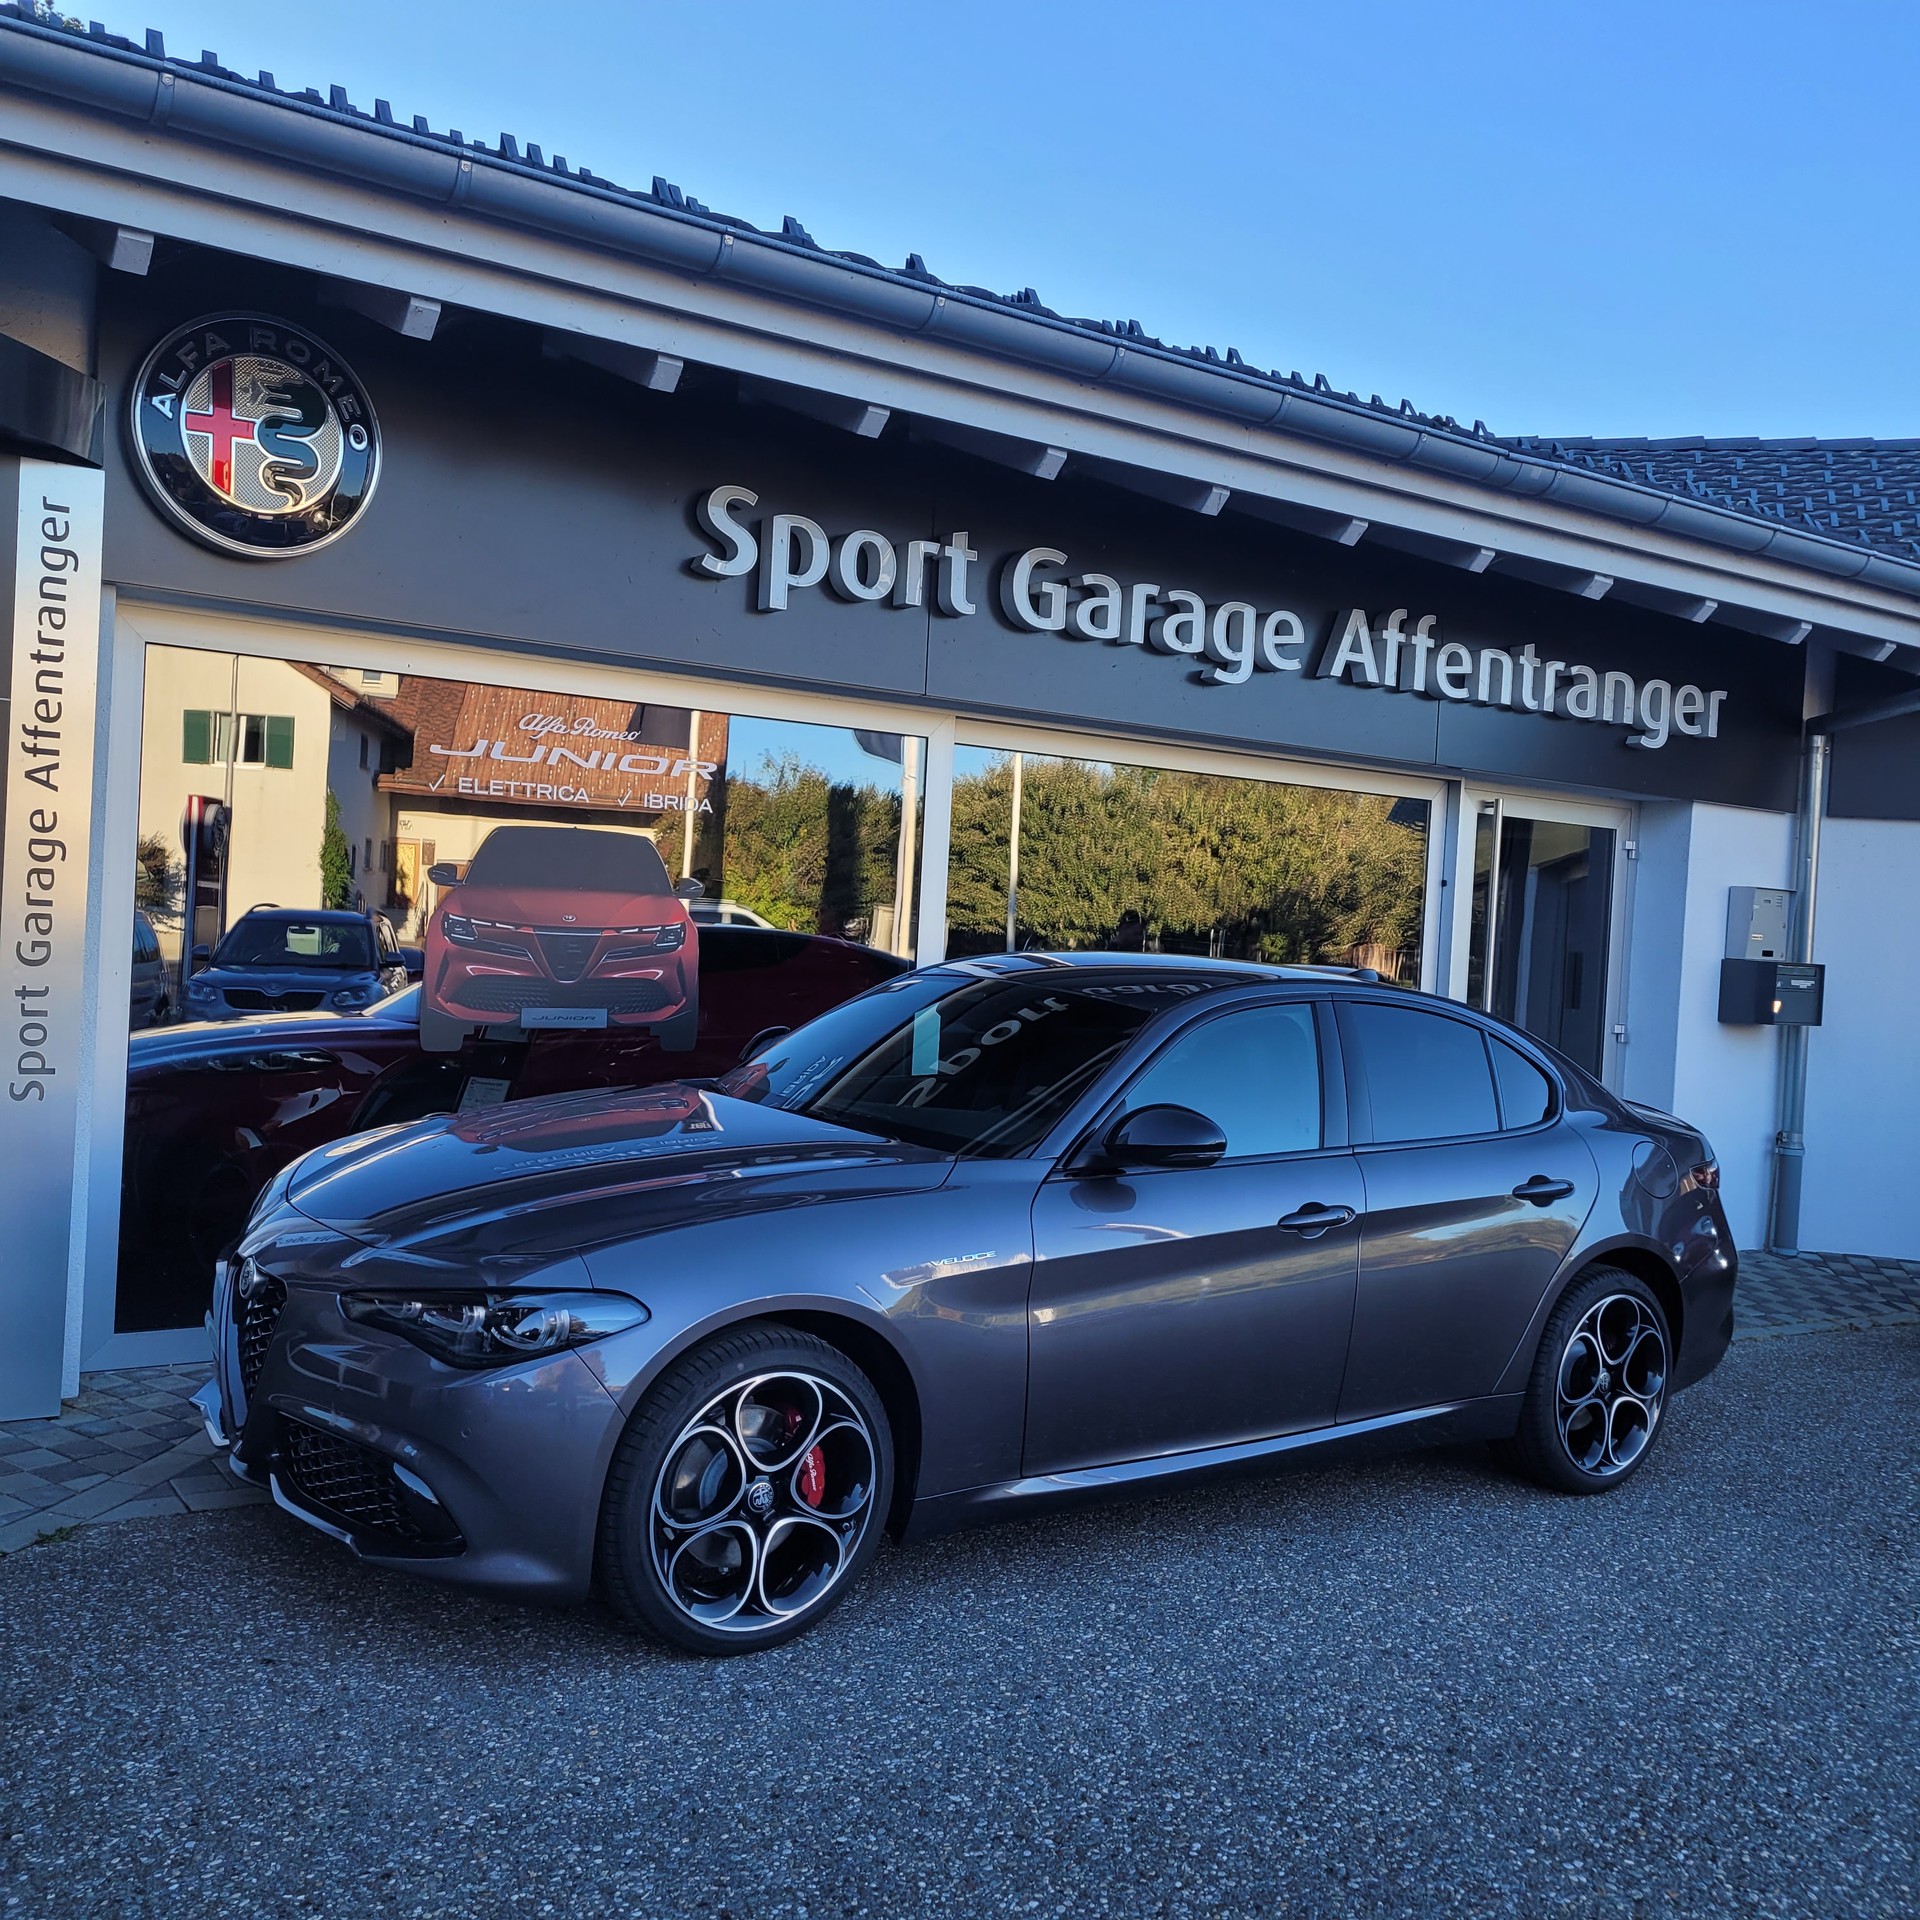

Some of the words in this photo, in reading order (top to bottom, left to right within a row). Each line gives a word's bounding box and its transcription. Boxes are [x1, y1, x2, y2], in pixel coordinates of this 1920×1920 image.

[151, 331, 232, 420] ALFA
[252, 327, 368, 451] ROMEO
[21, 496, 79, 793] Affentranger
[697, 485, 978, 614] Sport
[1003, 547, 1305, 684] Garage
[1324, 608, 1728, 749] Affentranger
[429, 738, 718, 781] JUNIOR
[518, 713, 571, 740] Alfa
[571, 716, 642, 742] Romeo
[458, 776, 590, 803] ELETTRICA
[643, 792, 714, 814] IBRIDA
[16, 808, 67, 968] Garage
[8, 984, 56, 1102] Sport
[531, 1014, 597, 1022] JUNIOR
[929, 1250, 997, 1267] VELOCE
